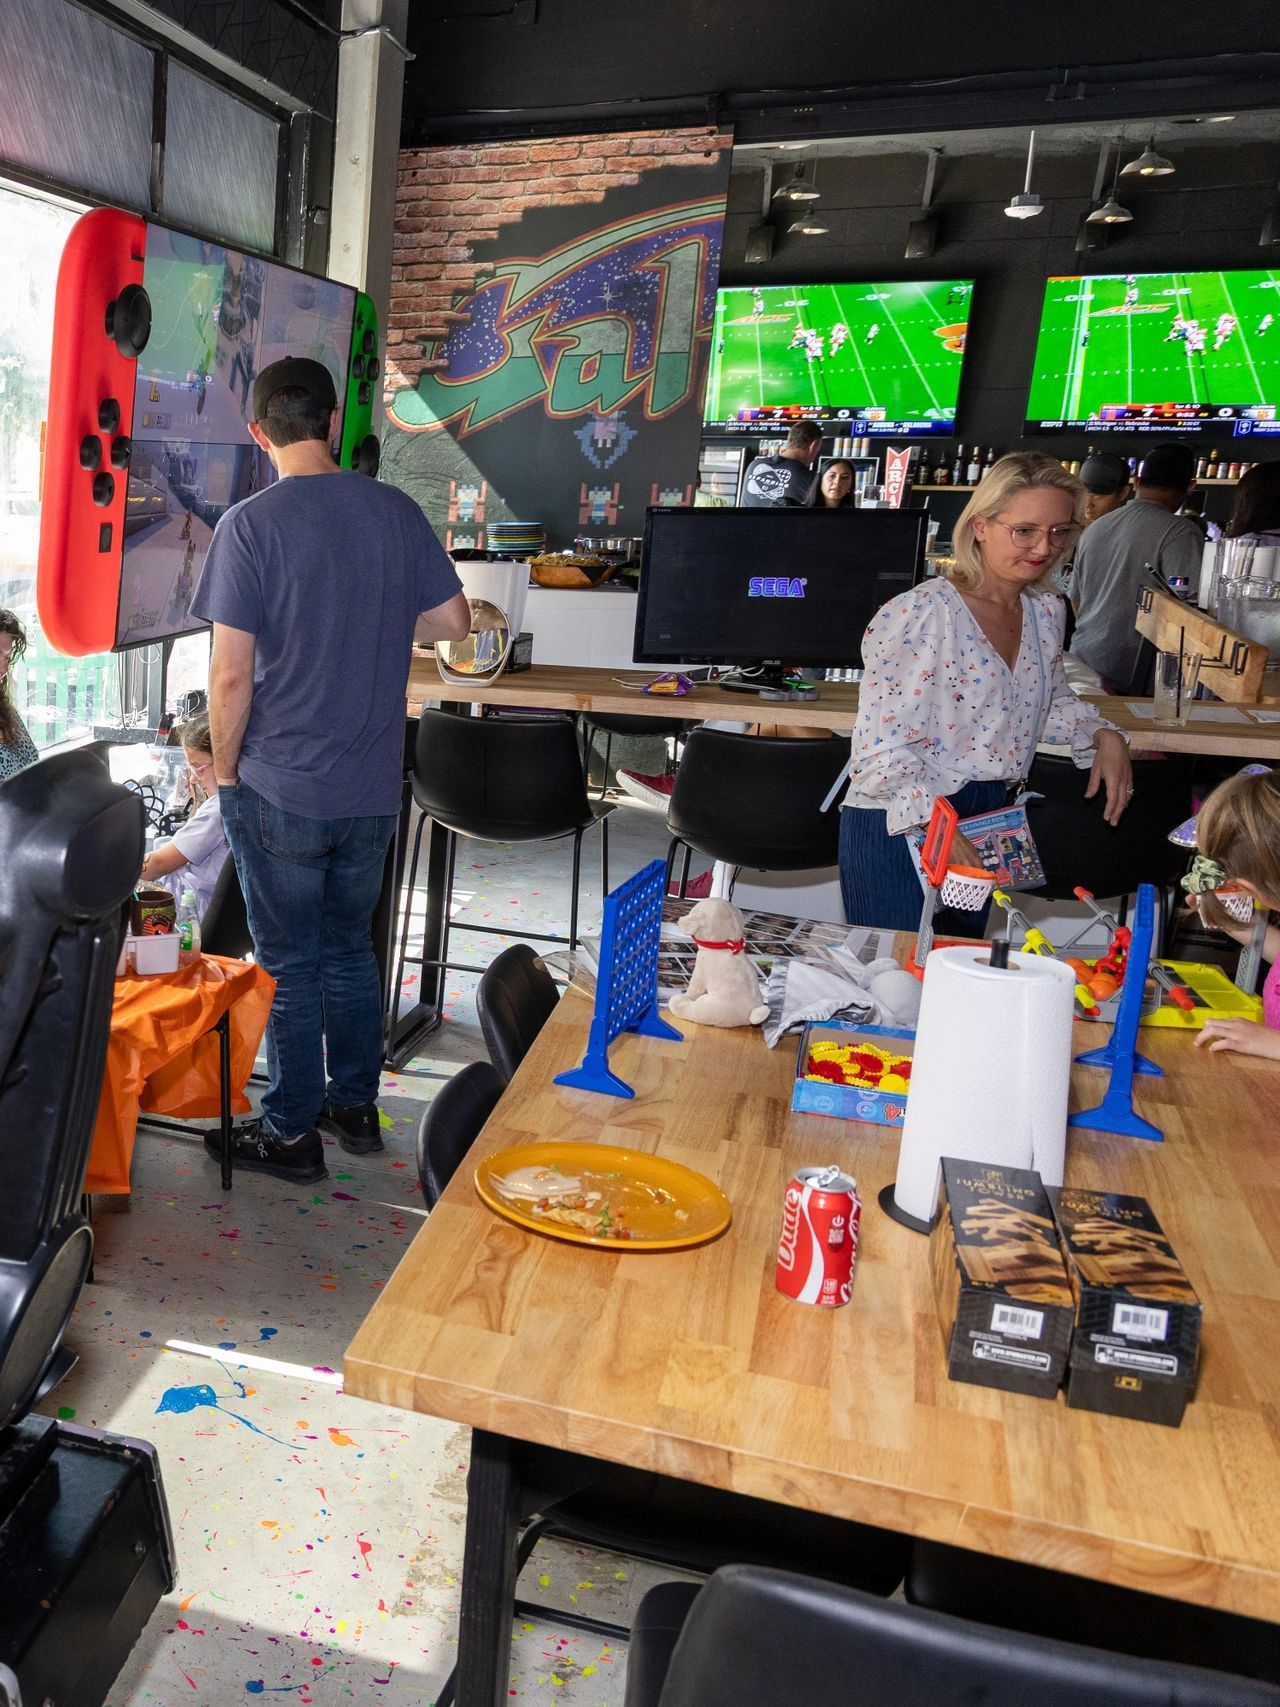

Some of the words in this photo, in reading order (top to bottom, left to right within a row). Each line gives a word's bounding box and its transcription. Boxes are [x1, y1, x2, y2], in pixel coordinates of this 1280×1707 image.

[1218, 407, 1233, 417] 0
[748, 577, 805, 598] SEGA
[955, 1178, 1036, 1198] JUMBLING
